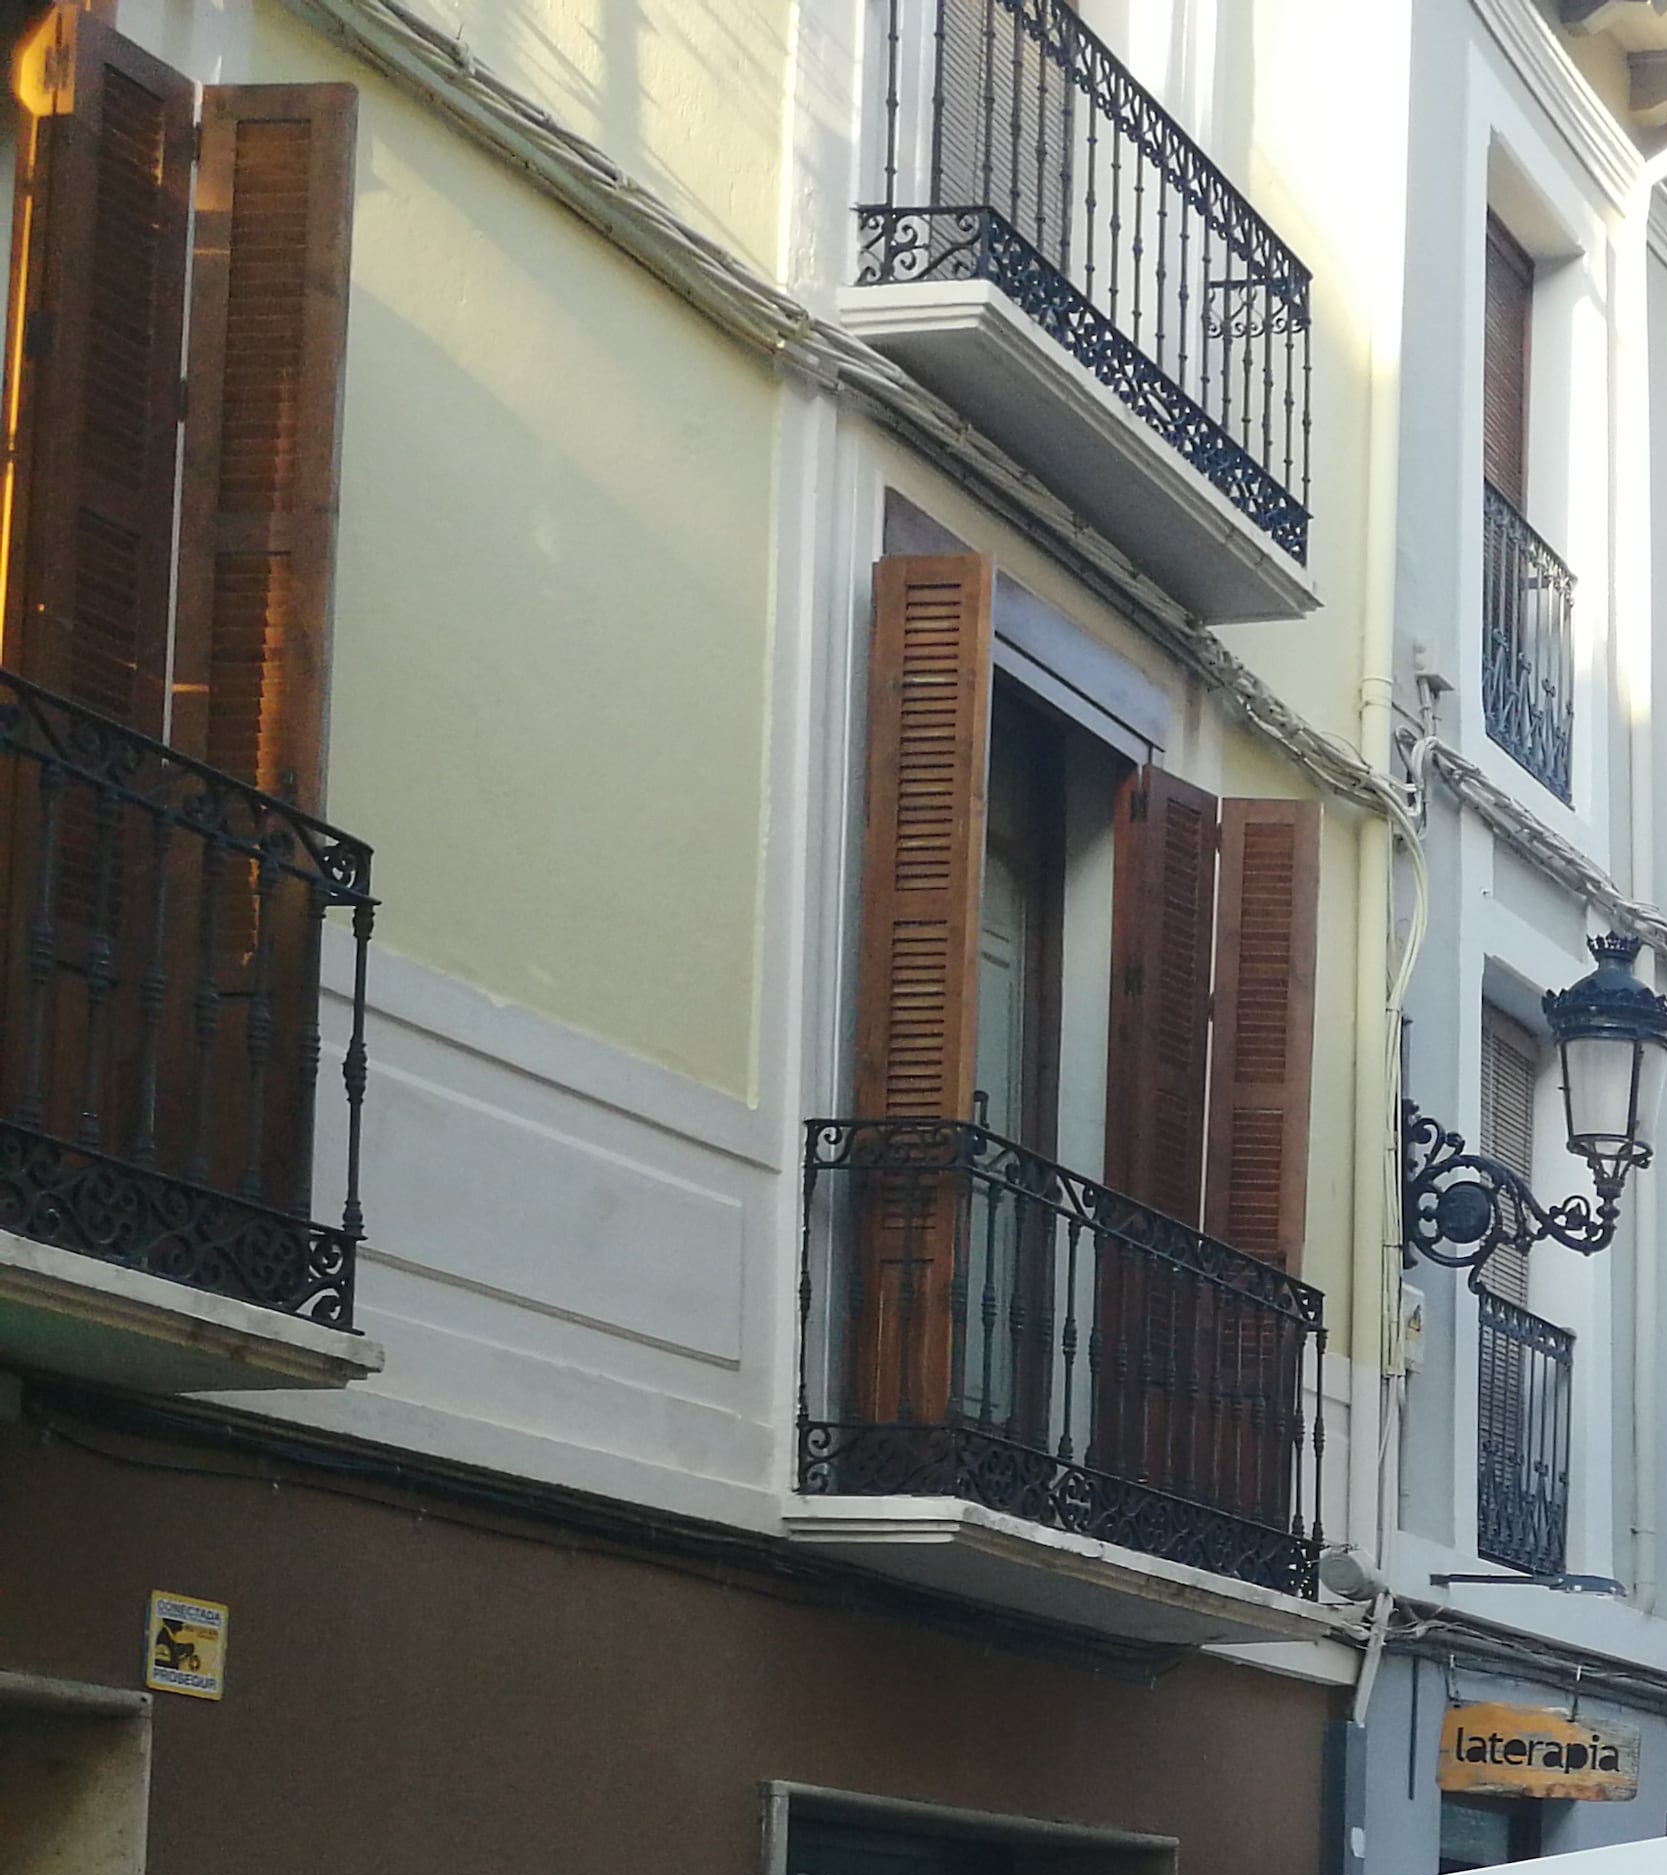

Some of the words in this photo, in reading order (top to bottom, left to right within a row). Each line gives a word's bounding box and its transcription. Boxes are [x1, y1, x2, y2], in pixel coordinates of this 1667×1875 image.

[156, 1600, 221, 1621] CONECTADA
[153, 1668, 218, 1690] PROSEGUR
[1455, 1727, 1620, 1774] laterapia
